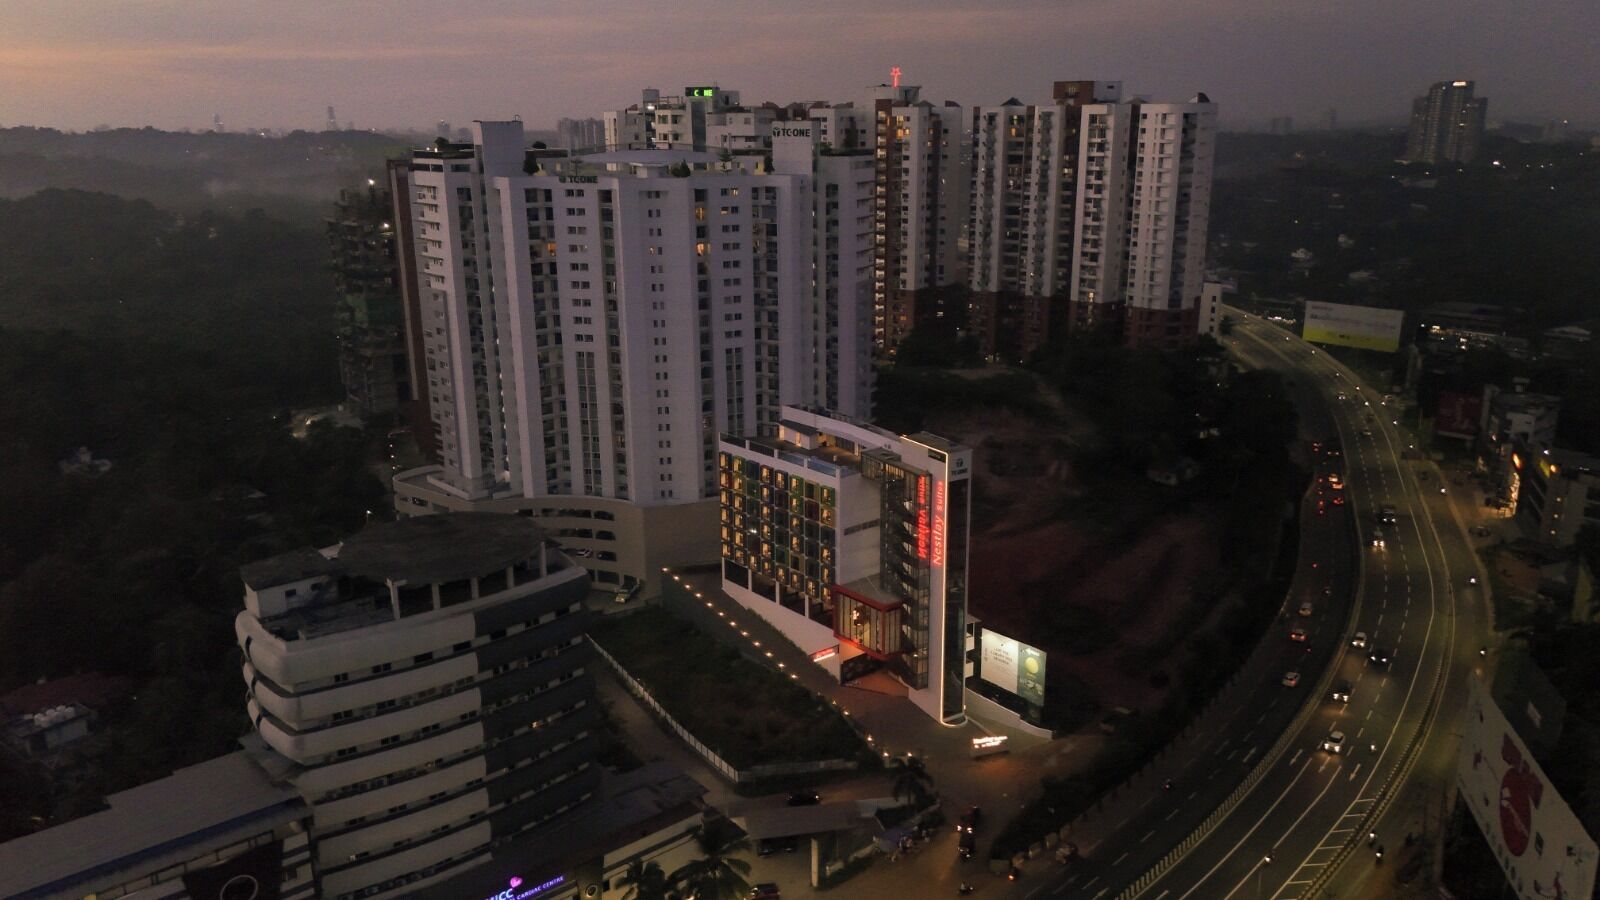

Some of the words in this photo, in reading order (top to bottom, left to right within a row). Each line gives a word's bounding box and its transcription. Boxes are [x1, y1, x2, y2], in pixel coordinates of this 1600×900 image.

[932, 515, 944, 566] Nestlay
[516, 886, 542, 900] CARDIAC
[542, 876, 564, 889] CENTRE
